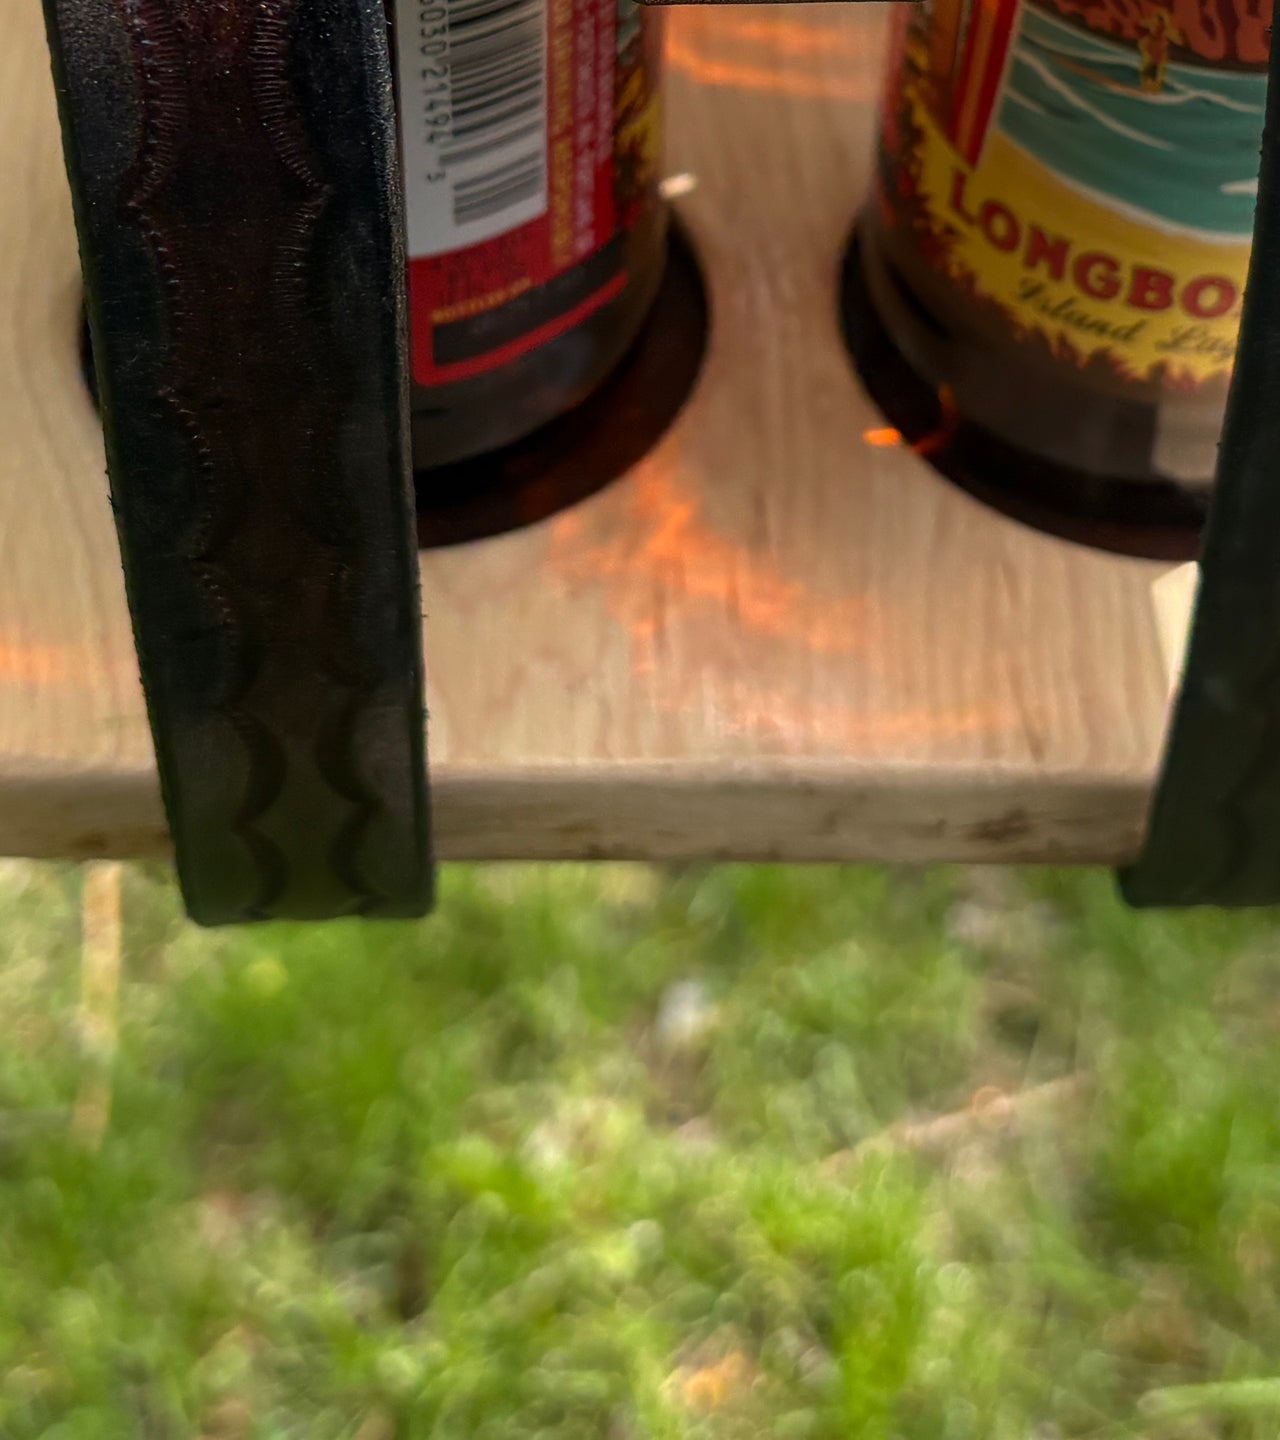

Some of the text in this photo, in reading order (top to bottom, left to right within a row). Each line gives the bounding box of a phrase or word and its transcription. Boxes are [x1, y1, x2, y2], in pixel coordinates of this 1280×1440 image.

[947, 167, 1242, 320] LONGBO
[1018, 276, 1237, 361] Island Lag
